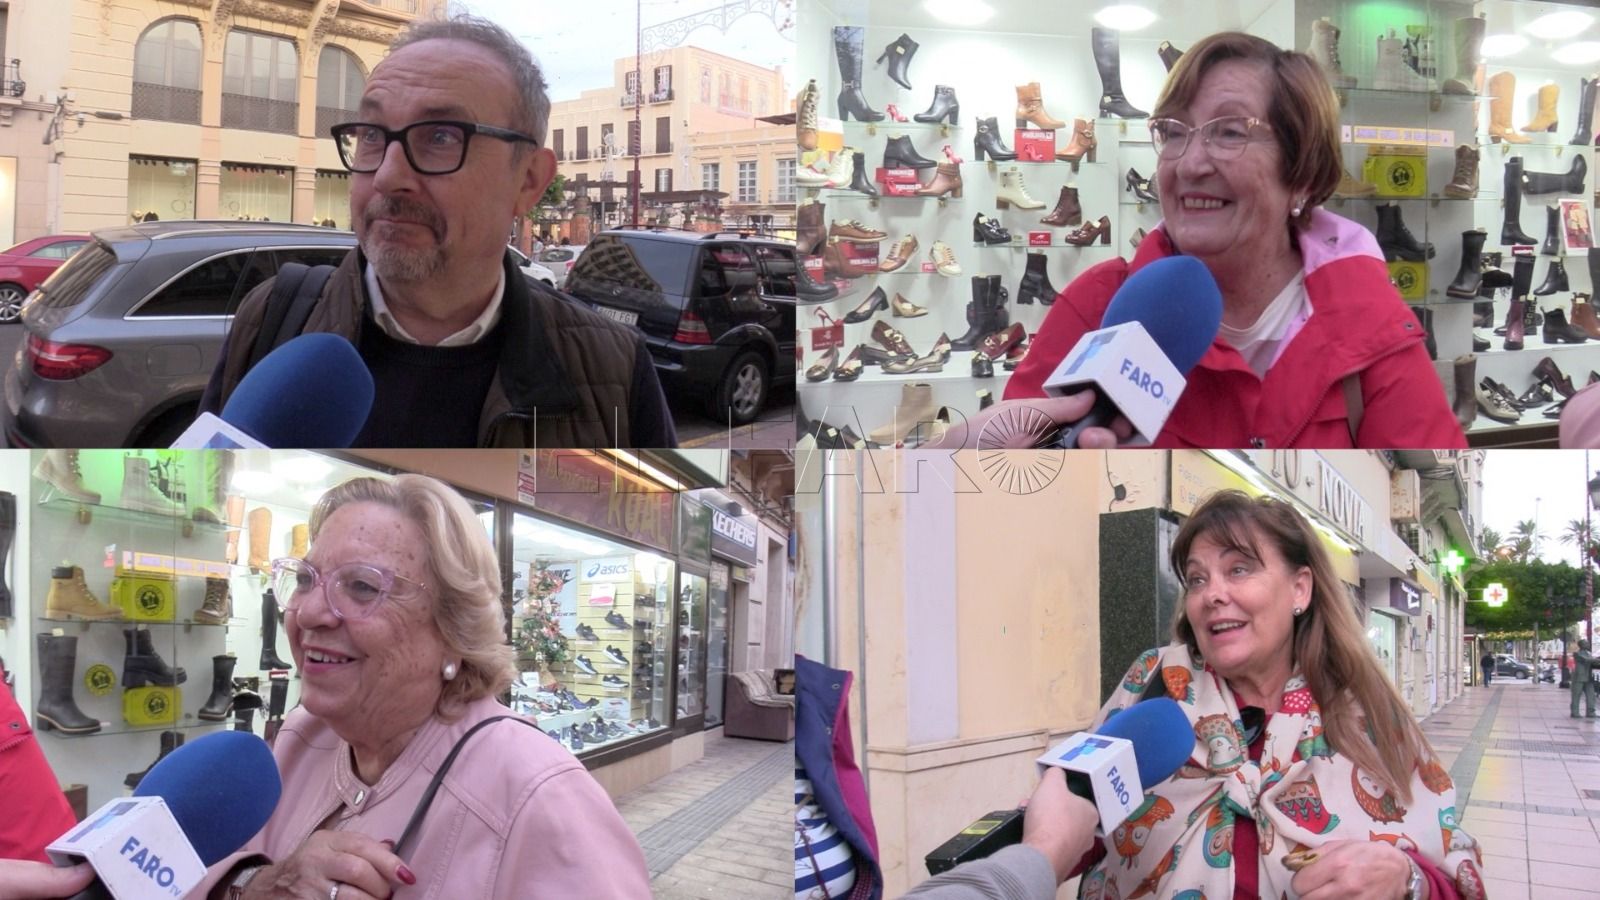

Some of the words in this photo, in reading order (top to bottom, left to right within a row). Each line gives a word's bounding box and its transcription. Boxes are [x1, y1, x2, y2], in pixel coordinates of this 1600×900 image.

[1120, 358, 1164, 399] FARO
[1317, 459, 1365, 542] NOVIA
[600, 565, 628, 575] asics
[1107, 765, 1130, 806] FARO
[120, 836, 174, 887] FARO
[169, 884, 181, 896] TV
